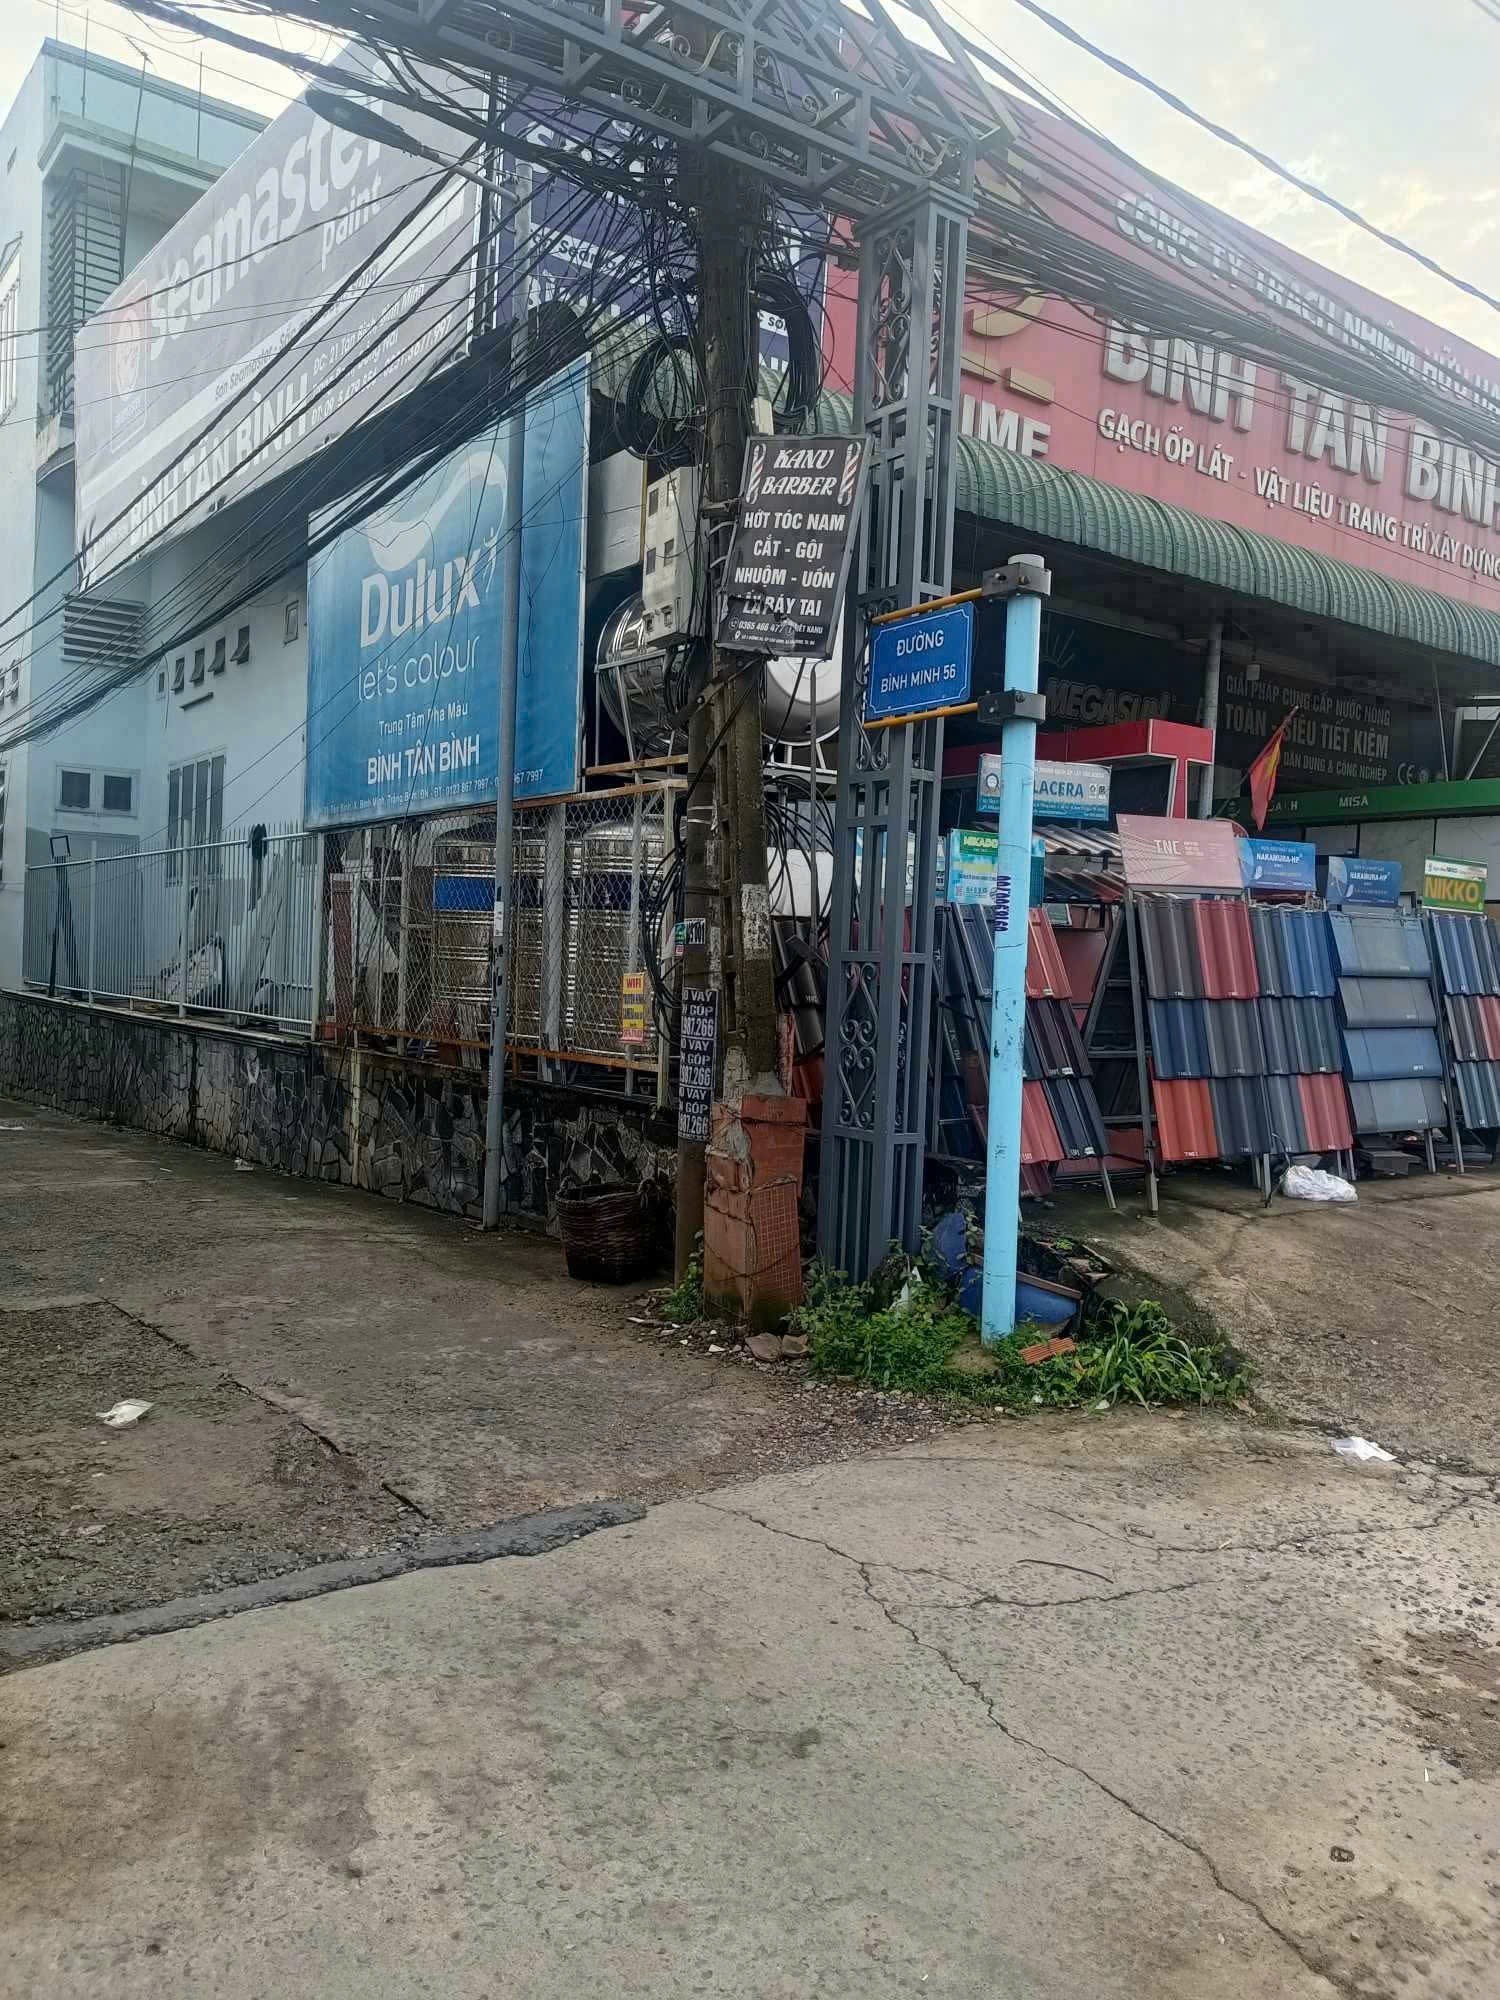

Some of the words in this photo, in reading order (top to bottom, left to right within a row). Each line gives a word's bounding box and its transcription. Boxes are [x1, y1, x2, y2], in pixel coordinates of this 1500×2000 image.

[321, 167, 383, 273] paint
[773, 448, 835, 469] KANU
[761, 476, 838, 496] BARBER
[1098, 407, 1161, 455] GẠCH
[1164, 424, 1195, 465] ỐP
[1197, 442, 1234, 482] LÁT
[1255, 465, 1290, 509] VẬT
[1293, 480, 1335, 523] LIỆU
[1338, 497, 1398, 542] TRANG
[1401, 520, 1430, 553] TRÍ
[744, 508, 771, 529] HỚT
[775, 508, 804, 530] TÓC
[806, 513, 846, 532] NAM
[753, 534, 782, 557] CẮT
[795, 538, 824, 563] GỘI
[734, 564, 787, 588] NHUỘM
[801, 566, 836, 589] UỐN
[361, 548, 481, 648] Dulux
[799, 598, 823, 617] TAI
[896, 629, 944, 657] ĐƯỜNG
[358, 657, 398, 702] let's
[404, 635, 481, 688] colour
[880, 672, 908, 693] BÌNH
[910, 666, 941, 687] MINH
[943, 663, 956, 681] 56
[1251, 678, 1280, 703] PHÁP
[1282, 687, 1311, 709] CUNG
[1312, 688, 1334, 714] CẤP
[1335, 696, 1362, 721] NƯỚC
[379, 719, 404, 737] Trung
[405, 712, 425, 729] Tâm
[427, 707, 445, 726] Pha
[1225, 702, 1267, 737] TOÀN
[1320, 717, 1350, 753] TIẾT
[1353, 727, 1389, 762] KIỆM
[367, 747, 402, 785] BÌNH
[404, 738, 436, 778] TÂN
[440, 731, 480, 772] BÌNH
[1336, 759, 1358, 778] CÔNG
[1359, 764, 1388, 785] NGHIỆP
[1034, 778, 1085, 799] LACERA
[1424, 876, 1480, 904] NIKKO
[690, 991, 712, 1002] VAY
[690, 1003, 713, 1015] GÓP
[688, 1040, 710, 1051] VAY
[686, 1088, 707, 1100] VAY
